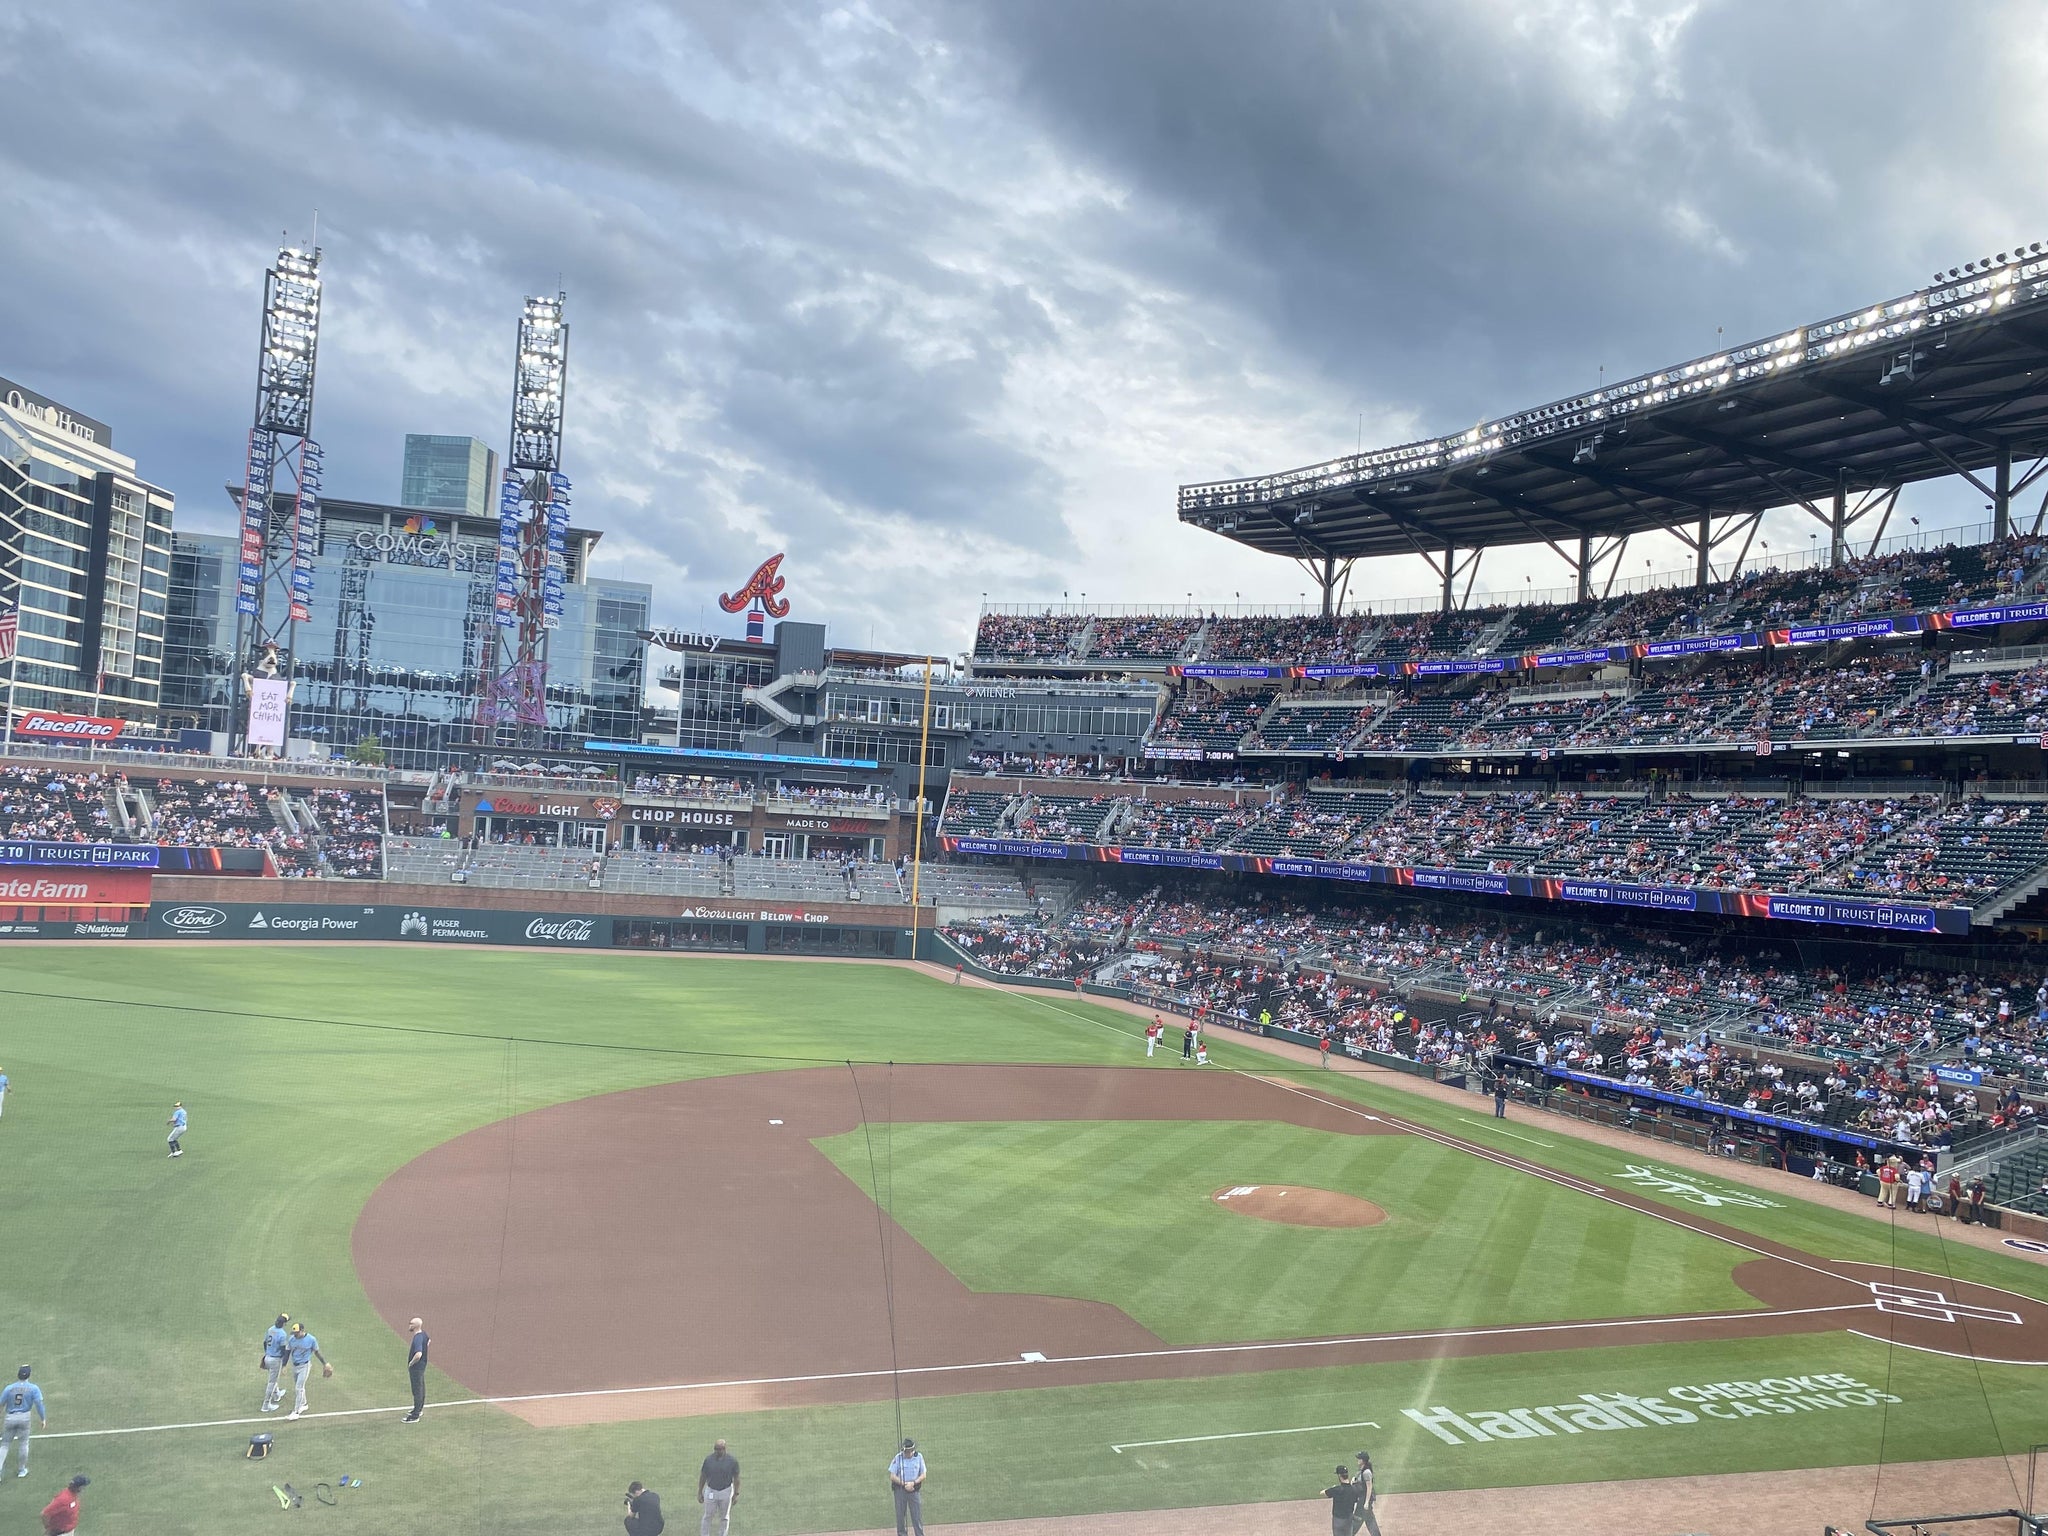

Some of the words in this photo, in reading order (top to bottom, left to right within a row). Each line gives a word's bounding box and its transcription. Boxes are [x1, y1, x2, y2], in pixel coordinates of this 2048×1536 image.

[7, 390, 44, 421] OMNI
[253, 431, 268, 443] 1872
[252, 448, 266, 460] 1874
[305, 442, 320, 454] 1873
[304, 458, 318, 470] 1875
[250, 466, 265, 477] 1877
[303, 475, 317, 486] 1878
[249, 482, 264, 494] 1883
[301, 492, 315, 503] 1891
[248, 499, 263, 511] 1892
[300, 508, 314, 519] 1893
[246, 516, 261, 528] 1897
[245, 533, 259, 544] 1914
[356, 531, 482, 560] COMCAST
[244, 550, 258, 561] 1957
[242, 567, 258, 578] 1969
[241, 584, 256, 595] 1991
[546, 586, 560, 595] 2020
[294, 591, 308, 602] 1992
[240, 600, 255, 611] 1993
[545, 601, 559, 611] 2022
[496, 614, 511, 624] 2023
[1955, 614, 1988, 624] WELCOME
[1990, 612, 2000, 620] TO
[2009, 607, 2043, 618] TRUIST
[1791, 630, 1818, 640] WELCOME
[1818, 629, 1826, 637] TO
[1832, 626, 1857, 636] TRUIST
[1868, 623, 1889, 632] PARK
[1650, 645, 1673, 653] WELCOME
[1686, 642, 1709, 650] TRUIST
[1719, 638, 1737, 646] PARK
[261, 692, 278, 701] EAT
[976, 687, 1016, 698] MILNER
[259, 701, 278, 712] MOR
[253, 711, 282, 722] CHIKIN
[26, 717, 113, 736] RaceTrac
[1540, 748, 1548, 760] 6
[1756, 741, 1771, 756] 10
[1336, 751, 1344, 761] 3
[494, 798, 537, 814] Coors
[540, 804, 580, 816] LIGHT
[632, 809, 675, 821] CHOP
[681, 812, 733, 825] HOUSE
[787, 820, 814, 828] MADE
[8, 847, 23, 857] TO
[38, 848, 90, 860] TRUIST
[114, 851, 150, 861] PARK
[960, 842, 988, 850] WELCOME
[1004, 845, 1030, 853] TRUIST
[1042, 847, 1063, 855] PARK
[1123, 852, 1151, 861] WELCOME
[1166, 855, 1190, 863] TRUIST
[1275, 863, 1303, 871] WELCOME
[1319, 866, 1342, 875] TRUIST
[1416, 874, 1439, 883] WELCOME
[1439, 875, 1446, 884] TO
[1451, 876, 1474, 886] TRUIST
[1485, 879, 1503, 889] PARK
[1566, 886, 1597, 897] WELCOME
[1598, 888, 1608, 898] TO
[1616, 890, 1648, 901] TRUIST
[1664, 895, 1690, 905] PARK
[174, 910, 216, 925] Ford
[695, 906, 726, 918] Coors
[727, 912, 755, 920] LIGHT
[760, 911, 792, 921] BELOW
[804, 913, 829, 923] CHOP
[1773, 902, 1812, 915] WELCOME
[1814, 906, 1824, 916] TO
[1835, 908, 1875, 921] TRUIST
[1895, 913, 1927, 925] PARK
[87, 925, 128, 933] National
[272, 917, 318, 930] Georgia
[322, 918, 358, 929] Power
[432, 920, 459, 928] KAISER
[526, 917, 596, 940] Coca-Cola
[1937, 1069, 1973, 1081] GEICO
[1668, 1373, 1869, 1402] CHEROKEE
[15, 1394, 23, 1406] 5
[1699, 1389, 1902, 1419] CASINOS
